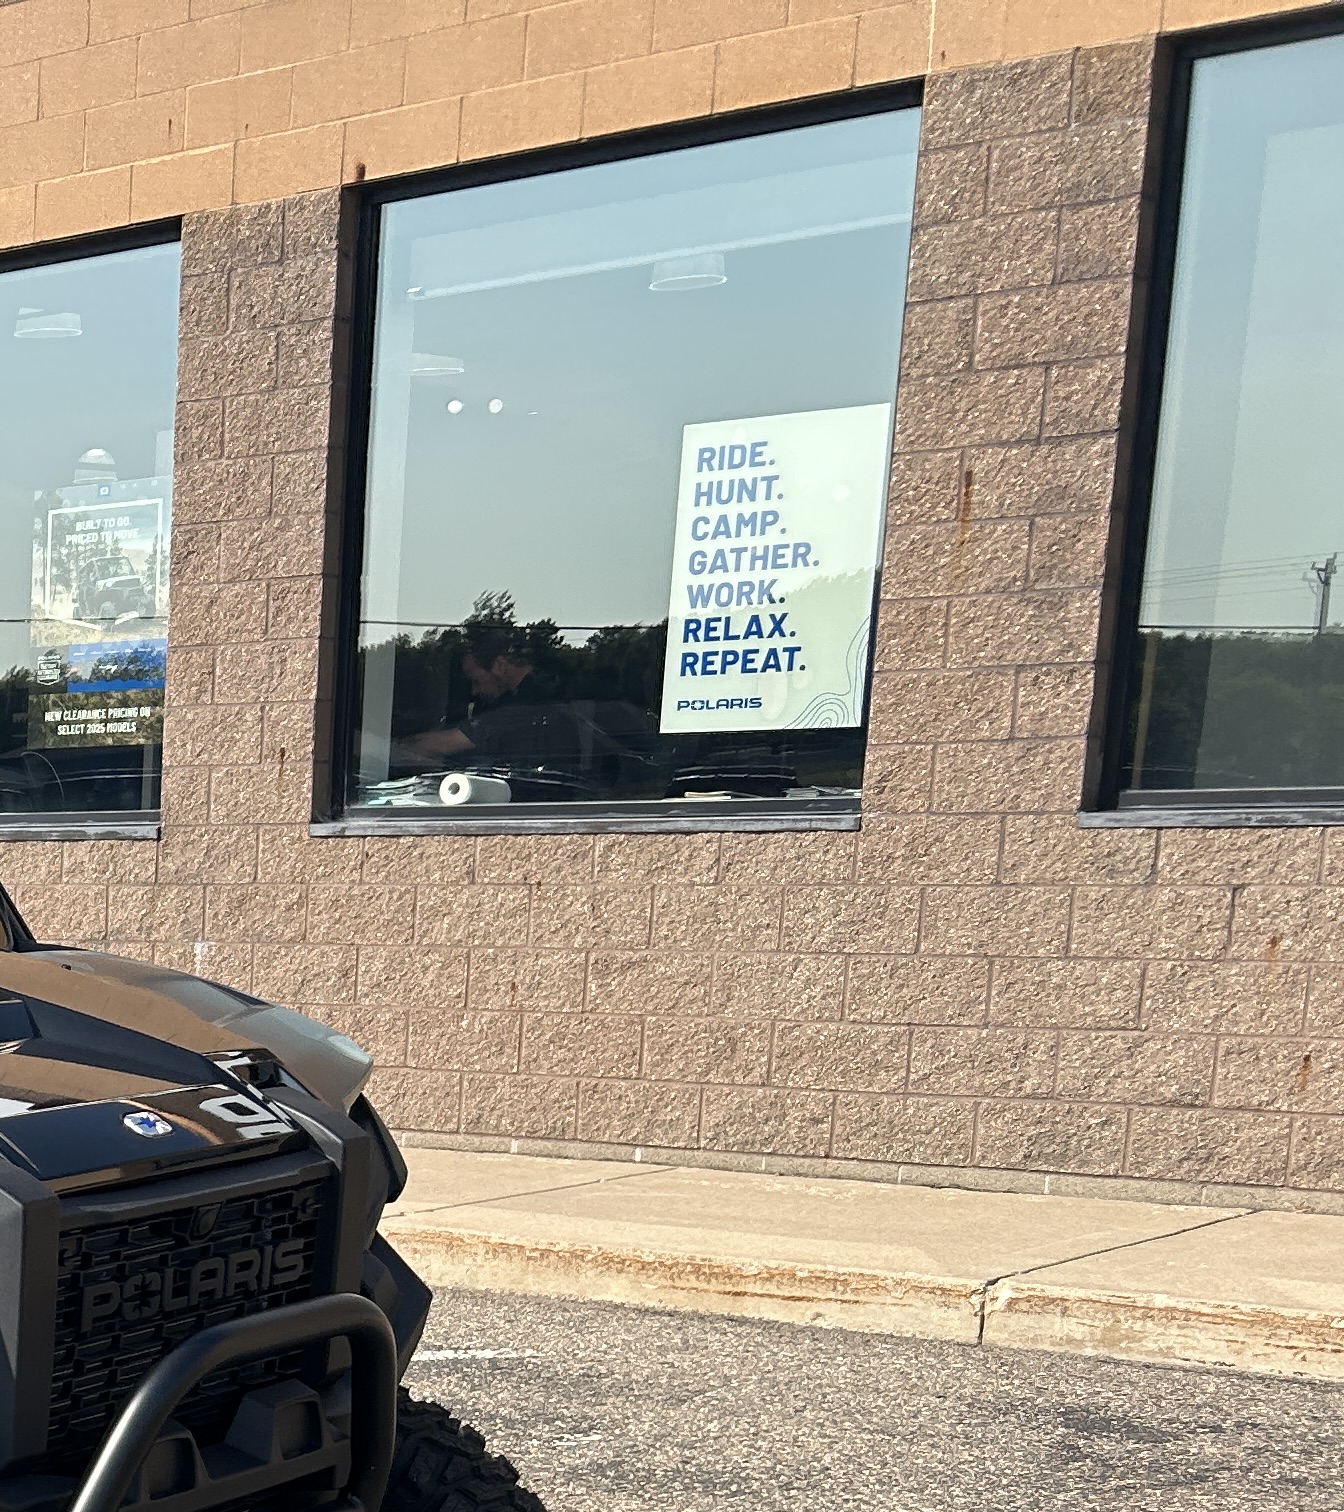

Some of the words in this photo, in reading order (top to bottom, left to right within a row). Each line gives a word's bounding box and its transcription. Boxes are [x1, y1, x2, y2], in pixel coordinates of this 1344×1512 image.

[697, 441, 776, 473] RIDE.
[693, 475, 784, 507] HUNT.
[75, 518, 102, 532] BUILT
[103, 518, 116, 528] TO
[690, 510, 787, 541] CAMP.
[688, 542, 820, 576] GATHER.
[686, 579, 786, 610] WORK.
[682, 613, 796, 644] RELAX.
[679, 646, 807, 678] REPEAT.
[44, 711, 63, 722] NEW
[63, 707, 107, 721] CLEARANCE
[108, 706, 138, 720] PRICING
[676, 697, 763, 712] POLARIS
[57, 723, 85, 735] SELECT
[86, 722, 106, 734] 2025
[107, 721, 137, 733] MODELS
[80, 1237, 305, 1334] POLARIS
